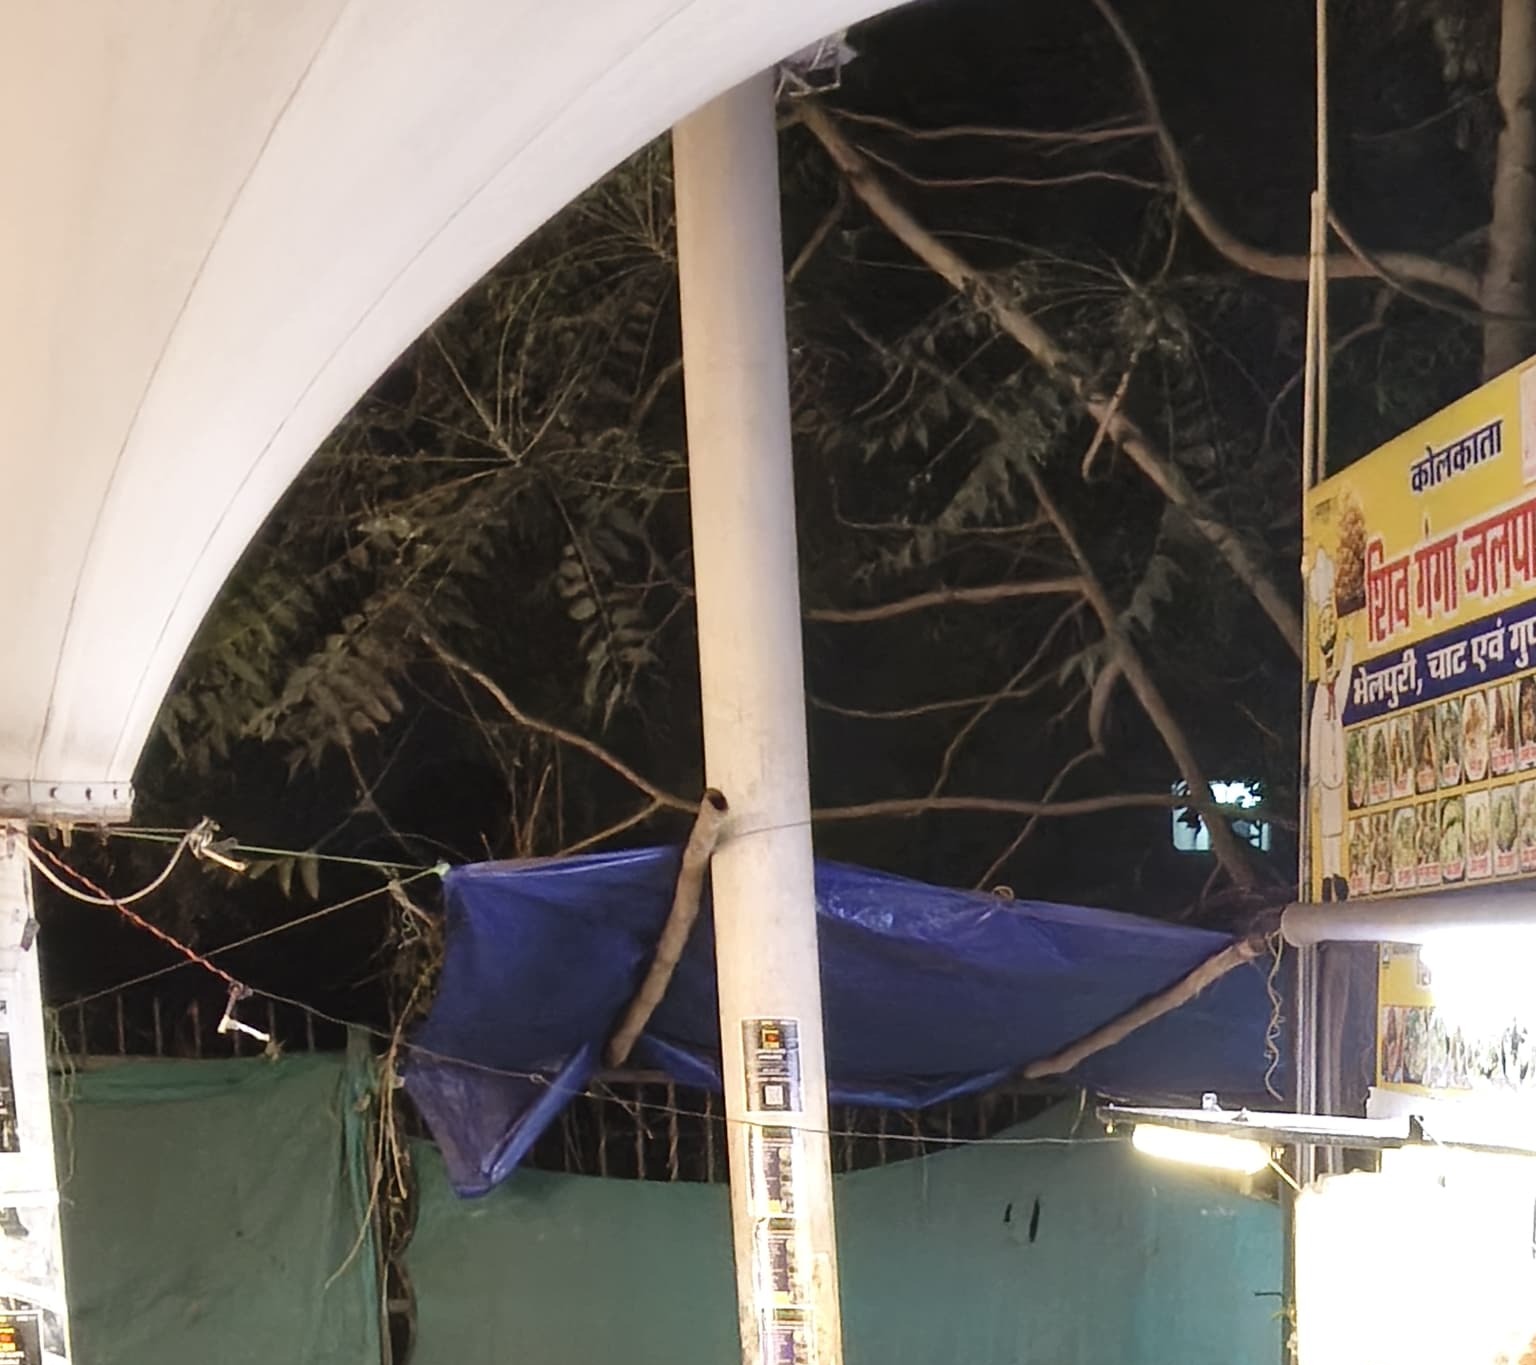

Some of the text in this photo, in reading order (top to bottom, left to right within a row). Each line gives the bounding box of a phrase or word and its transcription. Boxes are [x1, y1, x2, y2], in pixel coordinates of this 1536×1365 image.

[1411, 419, 1503, 492] कोलकाता
[1366, 539, 1410, 643] शिव
[1415, 518, 1458, 619] गंगा
[1427, 641, 1467, 680] चाट
[1471, 619, 1505, 673] एवं
